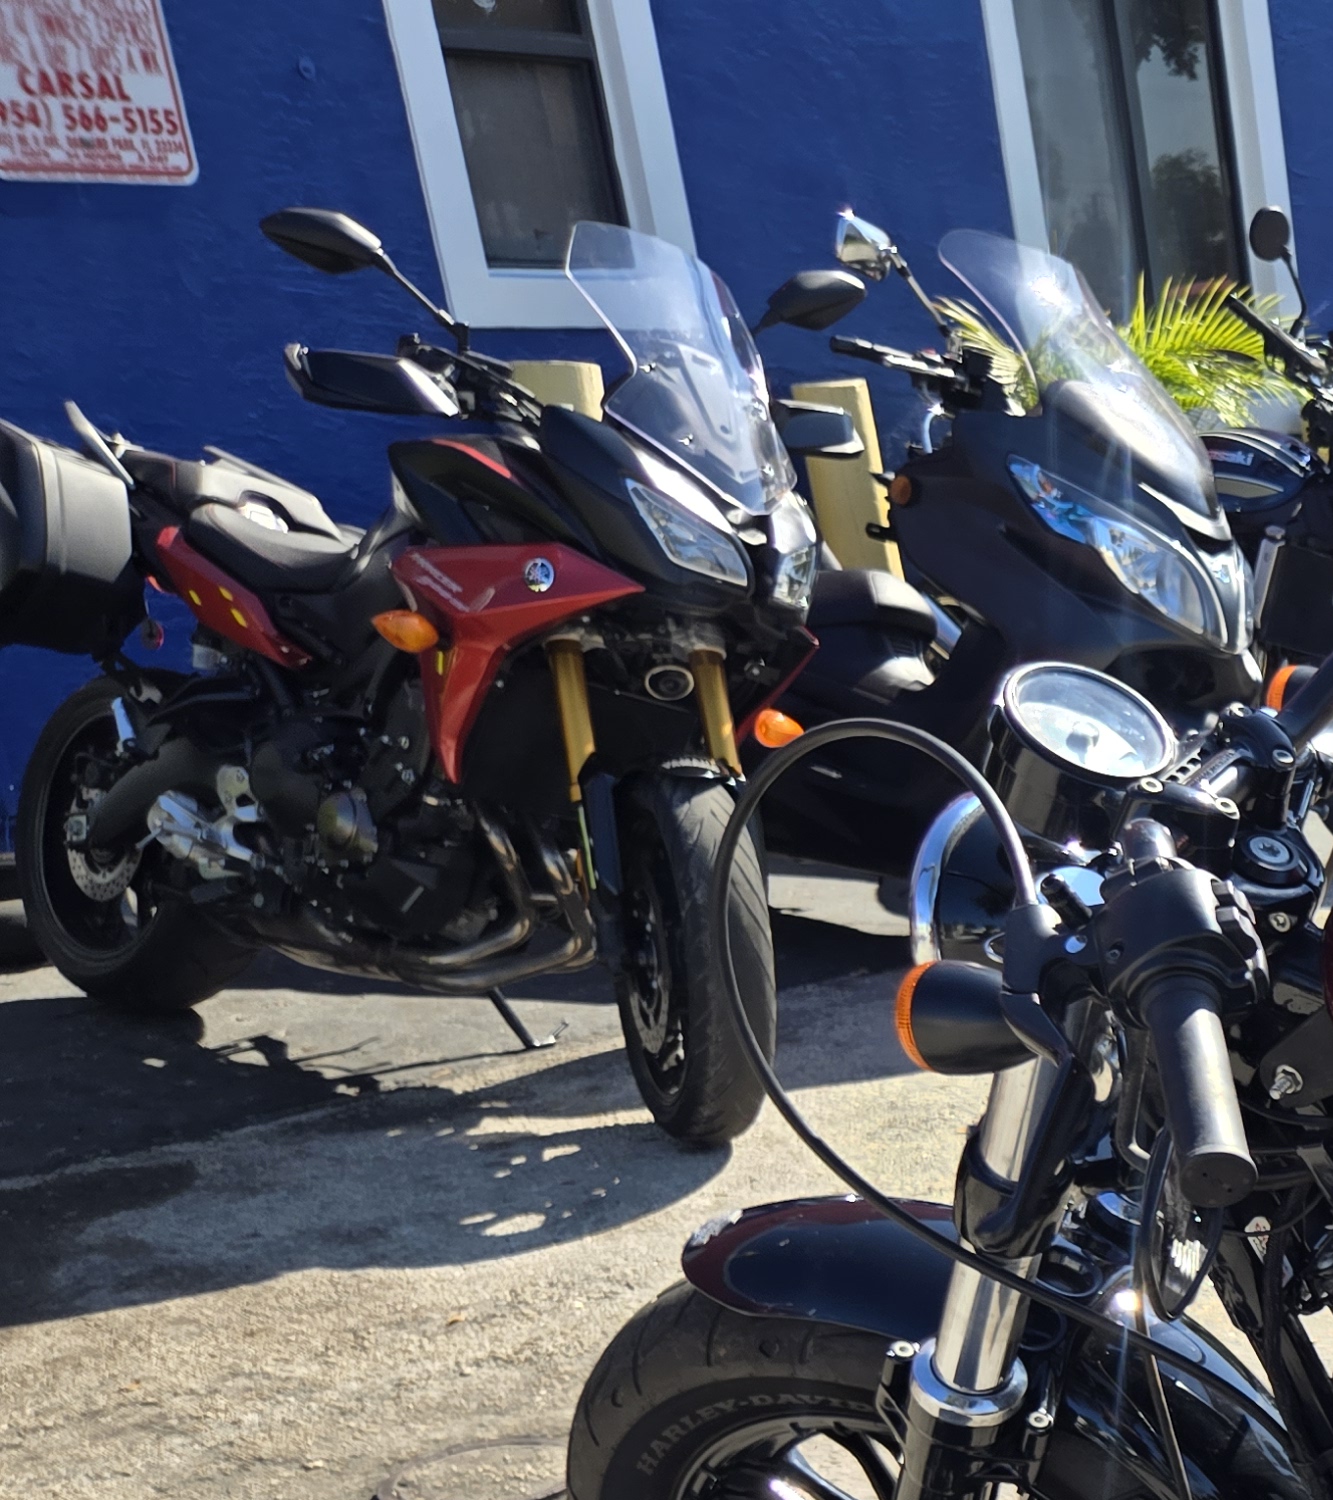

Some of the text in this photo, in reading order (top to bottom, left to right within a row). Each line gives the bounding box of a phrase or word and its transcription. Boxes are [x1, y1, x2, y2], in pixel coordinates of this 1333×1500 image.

[17, 64, 132, 102] CARSAL
[61, 102, 179, 136] 566-5155
[636, 1393, 878, 1476] HARLEY-DAVID
